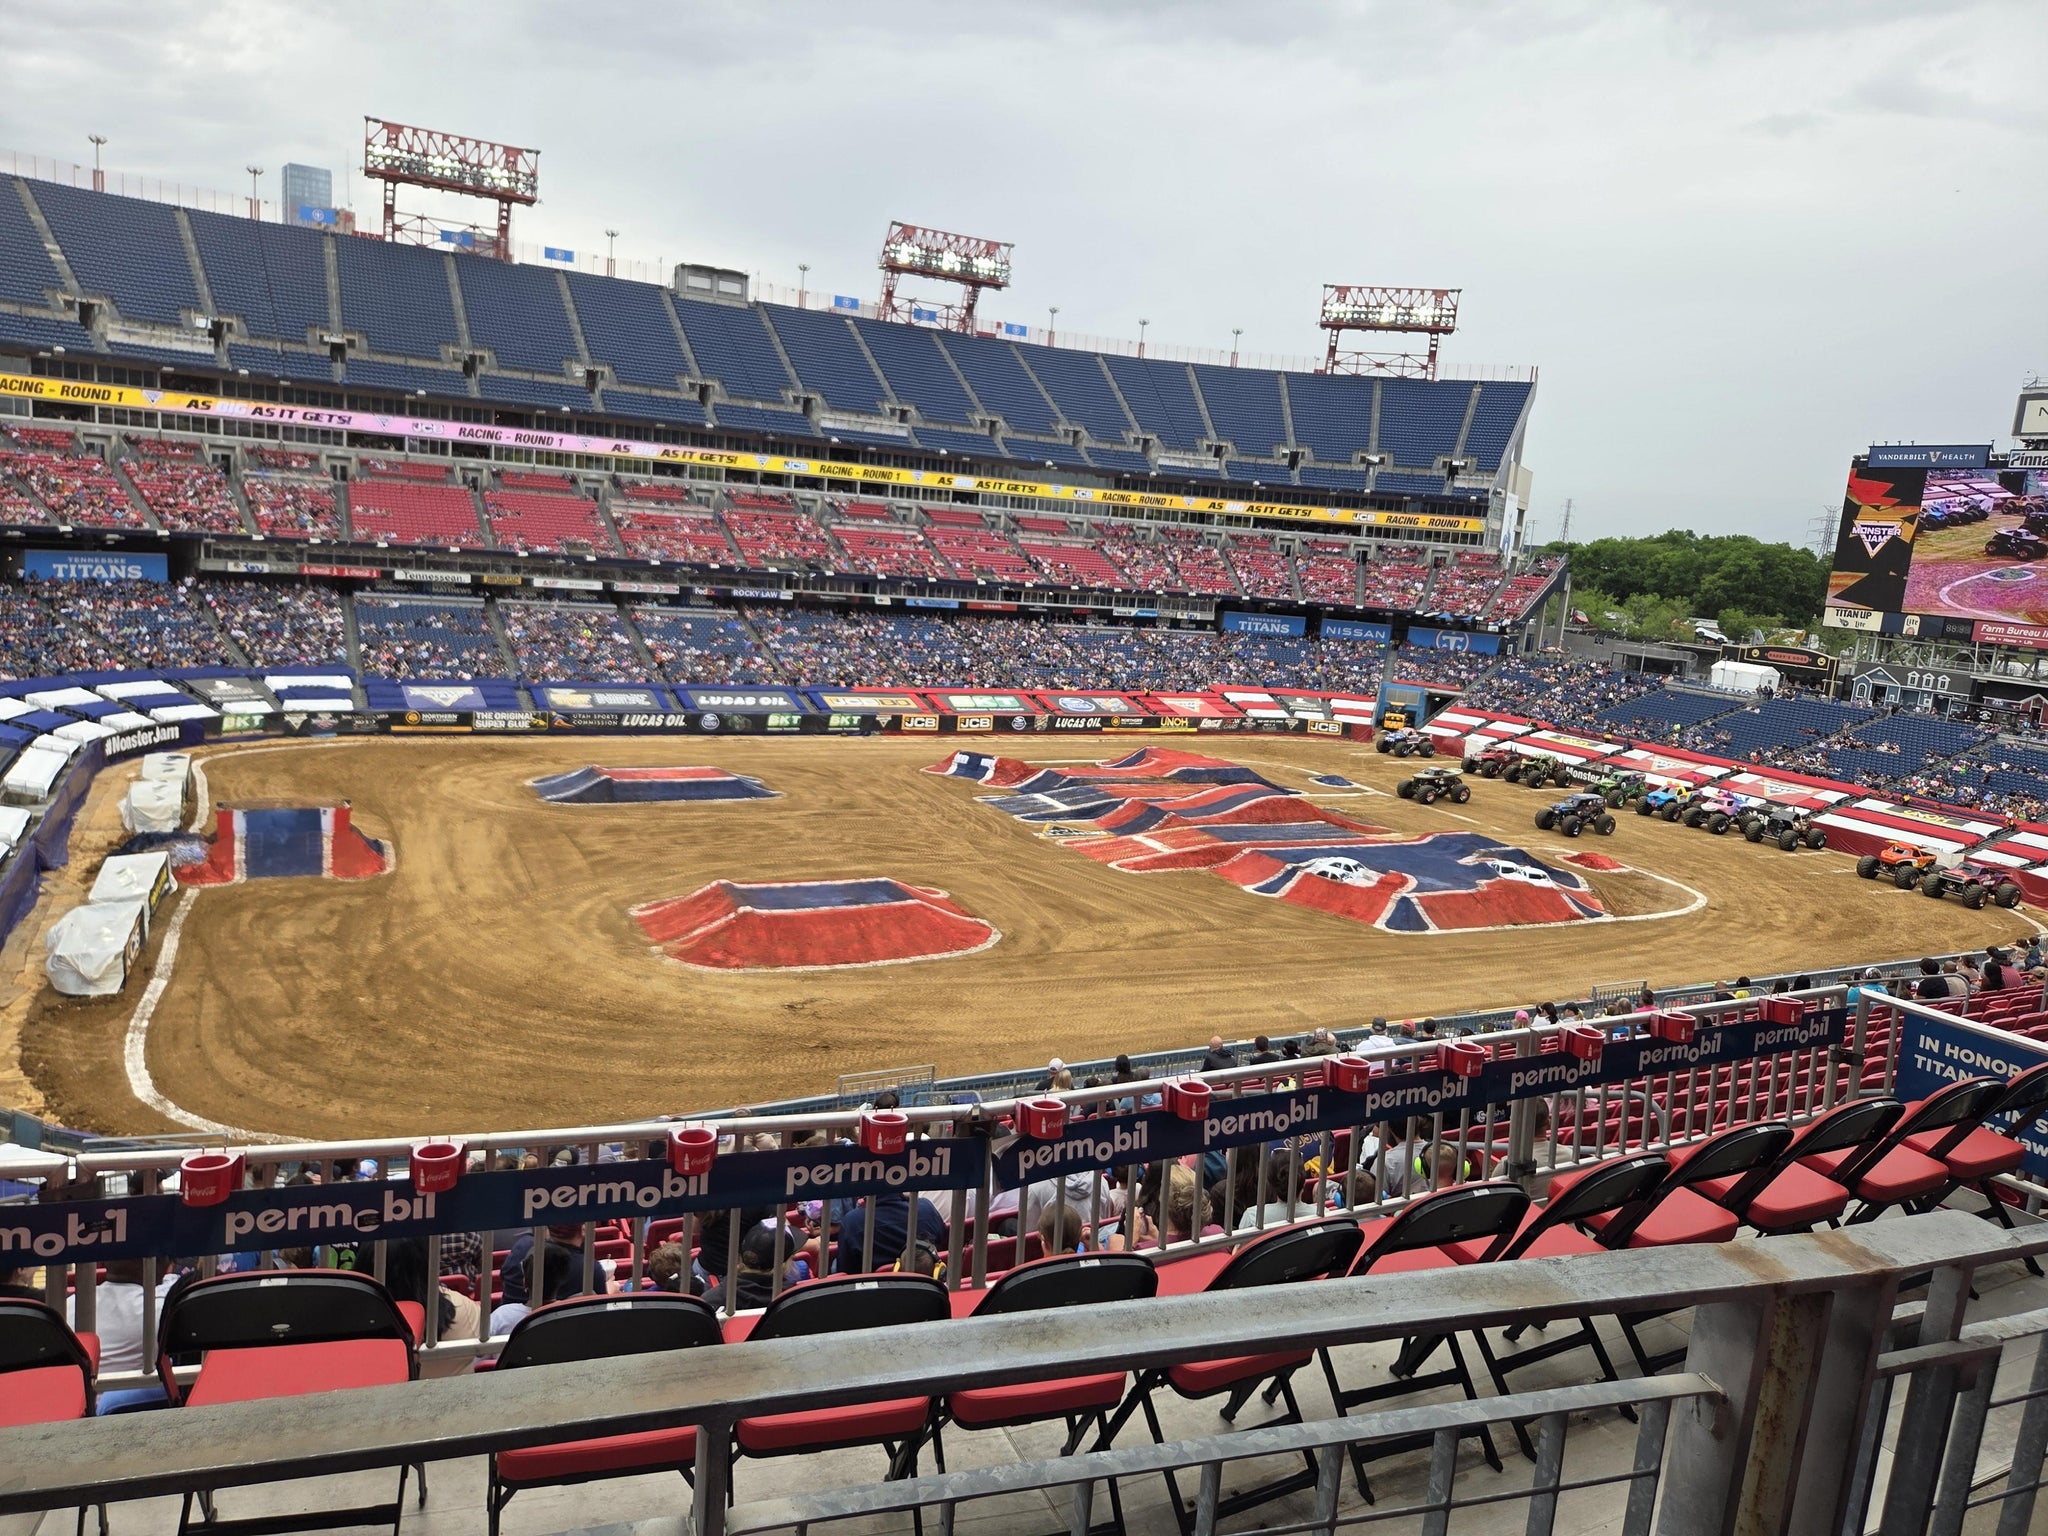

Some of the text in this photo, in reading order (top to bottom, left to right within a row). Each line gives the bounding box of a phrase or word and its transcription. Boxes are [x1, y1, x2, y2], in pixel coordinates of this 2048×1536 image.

[0, 377, 45, 394] ACING
[60, 384, 111, 402] ROUND
[117, 391, 124, 402] 1
[186, 399, 212, 411] AS
[251, 406, 275, 418] AS
[278, 408, 297, 419] IT
[302, 410, 353, 426] GETS!
[458, 427, 503, 441] RACING
[514, 433, 554, 446] ROUND
[558, 437, 564, 447] 1
[611, 443, 630, 453] AS
[660, 449, 680, 458] AS
[682, 451, 697, 460] IT
[700, 453, 738, 465] GETS!
[1878, 453, 1926, 461] VANDERBILT
[1941, 453, 1976, 461] HEALTH
[820, 464, 853, 477] RACING
[862, 469, 893, 481] ROUND
[896, 473, 901, 481] 1
[937, 477, 954, 486] AS
[976, 480, 992, 490] AS
[992, 482, 1004, 491] IT
[1006, 484, 1037, 494] GETS!
[1101, 492, 1131, 503] RACING
[1138, 495, 1167, 506] ROUND
[1168, 498, 1173, 507] 1
[1208, 502, 1224, 511] AS
[1246, 505, 1263, 514] AS
[1263, 506, 1276, 515] IT
[1277, 507, 1312, 518] GETS!
[1352, 513, 1376, 523] JCB
[1385, 515, 1419, 526] RACING
[1428, 518, 1460, 528] ROUND
[1851, 526, 1902, 537] MONSTER
[1863, 534, 1888, 543] JAM
[68, 556, 127, 564] TENNESSEE
[52, 563, 143, 579] TITANS
[695, 587, 715, 596] FedEx
[733, 589, 779, 599] ROCKY LAW
[1836, 608, 1872, 620] TITAN UP
[1238, 620, 1290, 634] TITANS
[1906, 618, 1919, 627] Lite
[1326, 626, 1386, 639] NISSAN
[1981, 624, 2005, 634] Farm
[2006, 627, 2040, 638] Bureau
[698, 695, 757, 706] LUCAS
[475, 712, 535, 720] THE ORIGINAL
[622, 714, 664, 726] LUCAS
[768, 714, 802, 727] BKT
[829, 714, 861, 727] BKT
[905, 717, 936, 728] JCB
[1055, 717, 1086, 728] LUCAS
[1160, 716, 1188, 727] UNOH
[475, 719, 531, 728] SUPER GLUE
[960, 718, 991, 728] JCB
[1310, 721, 1339, 733] JCB
[1753, 1014, 1830, 1053] permobil
[1918, 1034, 1940, 1054] IN
[1637, 1032, 1722, 1072] permobil
[1510, 1054, 1602, 1095] permobil
[1365, 1074, 1469, 1118] permobil
[1203, 1094, 1319, 1146] permobil
[1018, 1120, 1148, 1179] permobil
[786, 1146, 952, 1196] permobil
[523, 1168, 709, 1219] permobil
[225, 1190, 437, 1246] permobil
